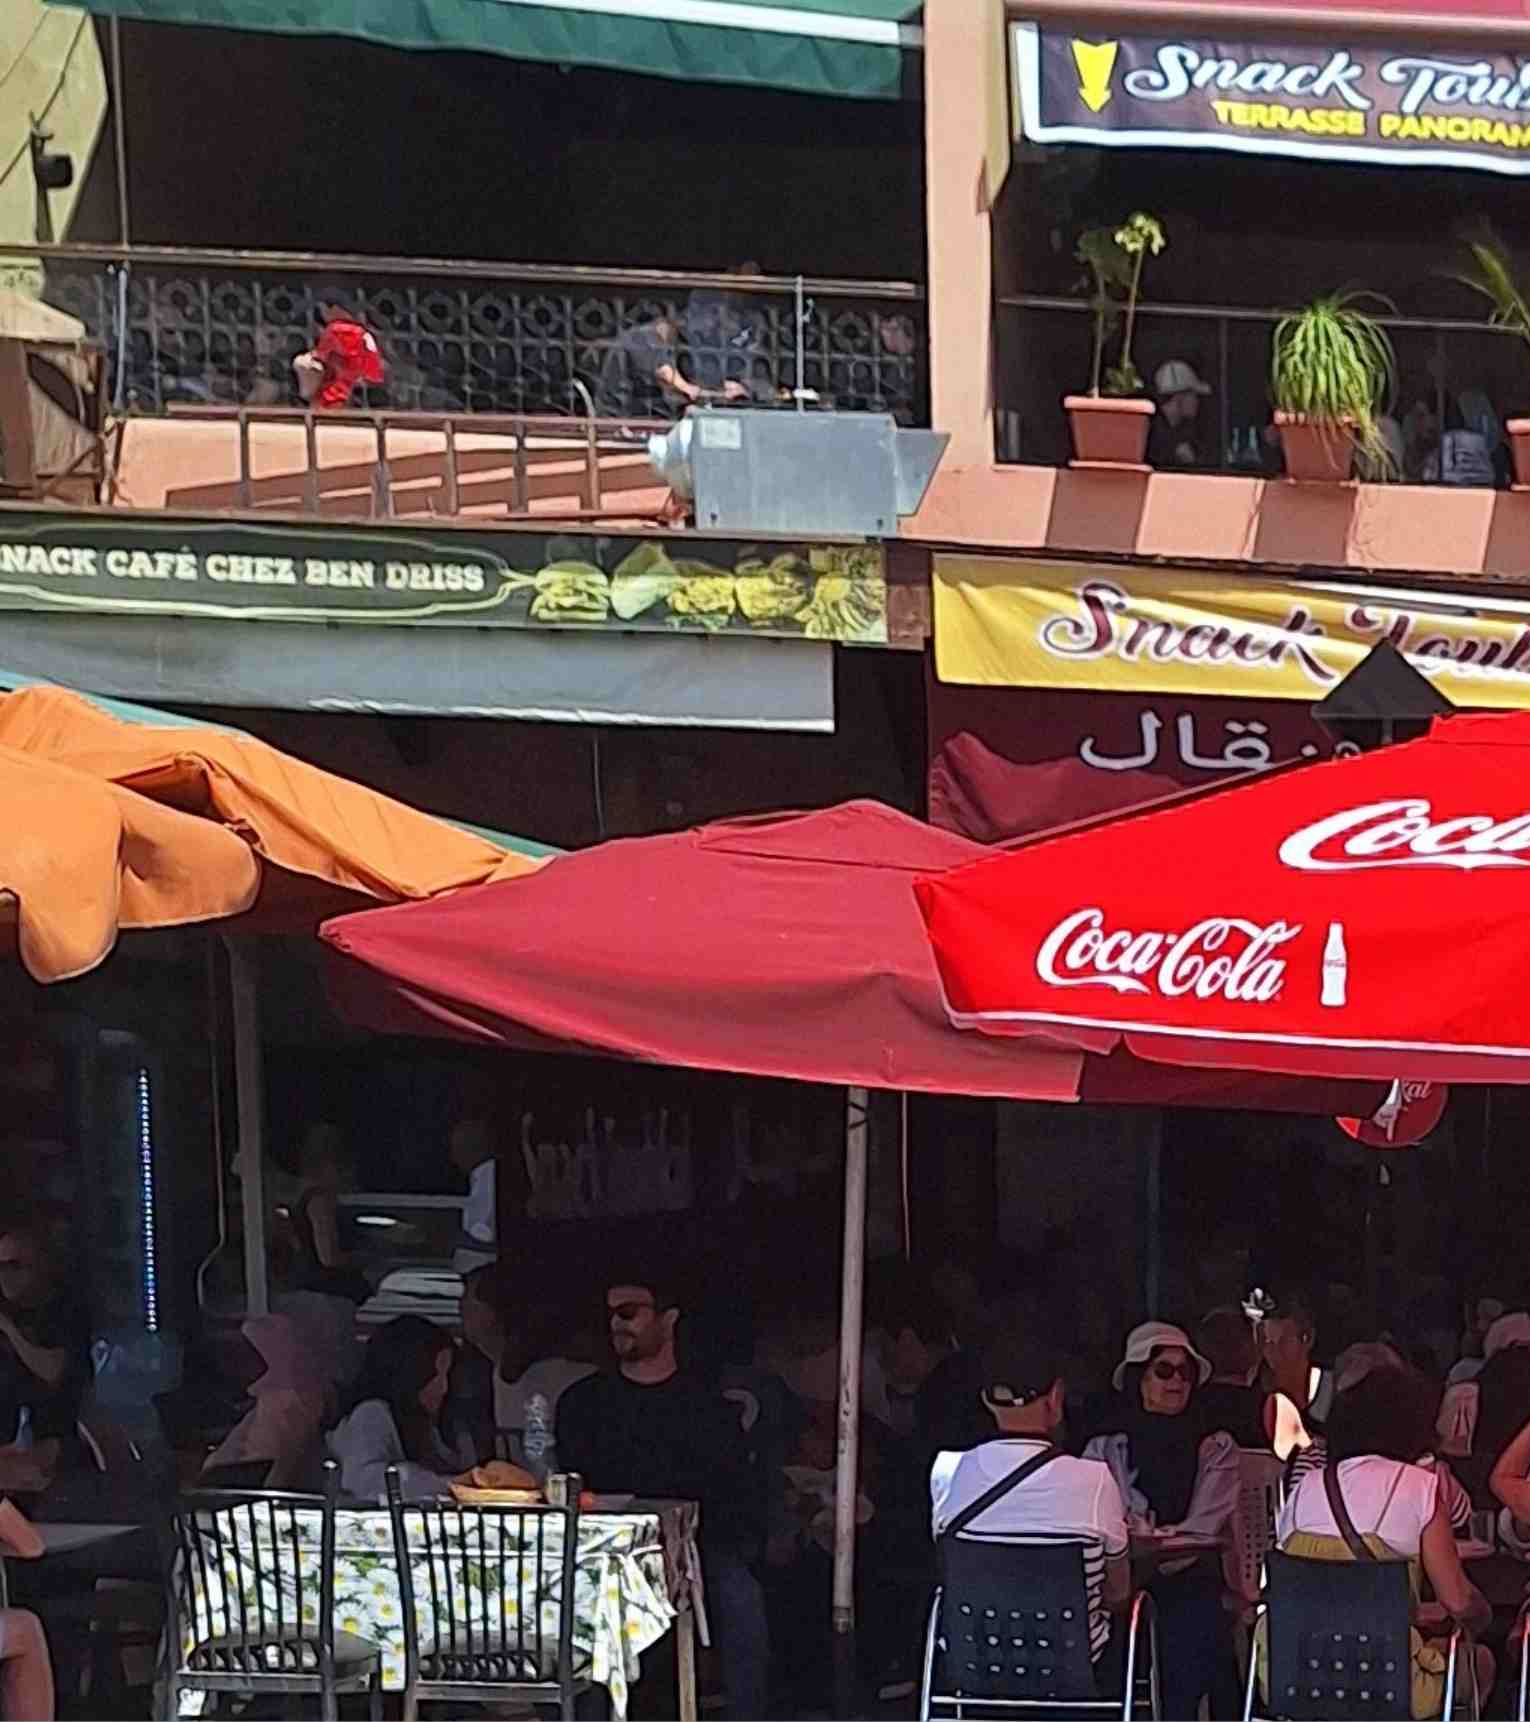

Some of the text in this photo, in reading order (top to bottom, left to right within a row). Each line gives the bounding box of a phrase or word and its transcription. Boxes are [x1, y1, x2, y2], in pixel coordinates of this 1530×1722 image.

[1125, 44, 1372, 110] Snack
[1212, 100, 1365, 136] TERRASSE
[0, 544, 484, 591] NACK CAFÉ CHEZ BEN DRISS
[1040, 582, 1341, 683] Snack
[1035, 908, 1302, 1001] Coca-Cola
